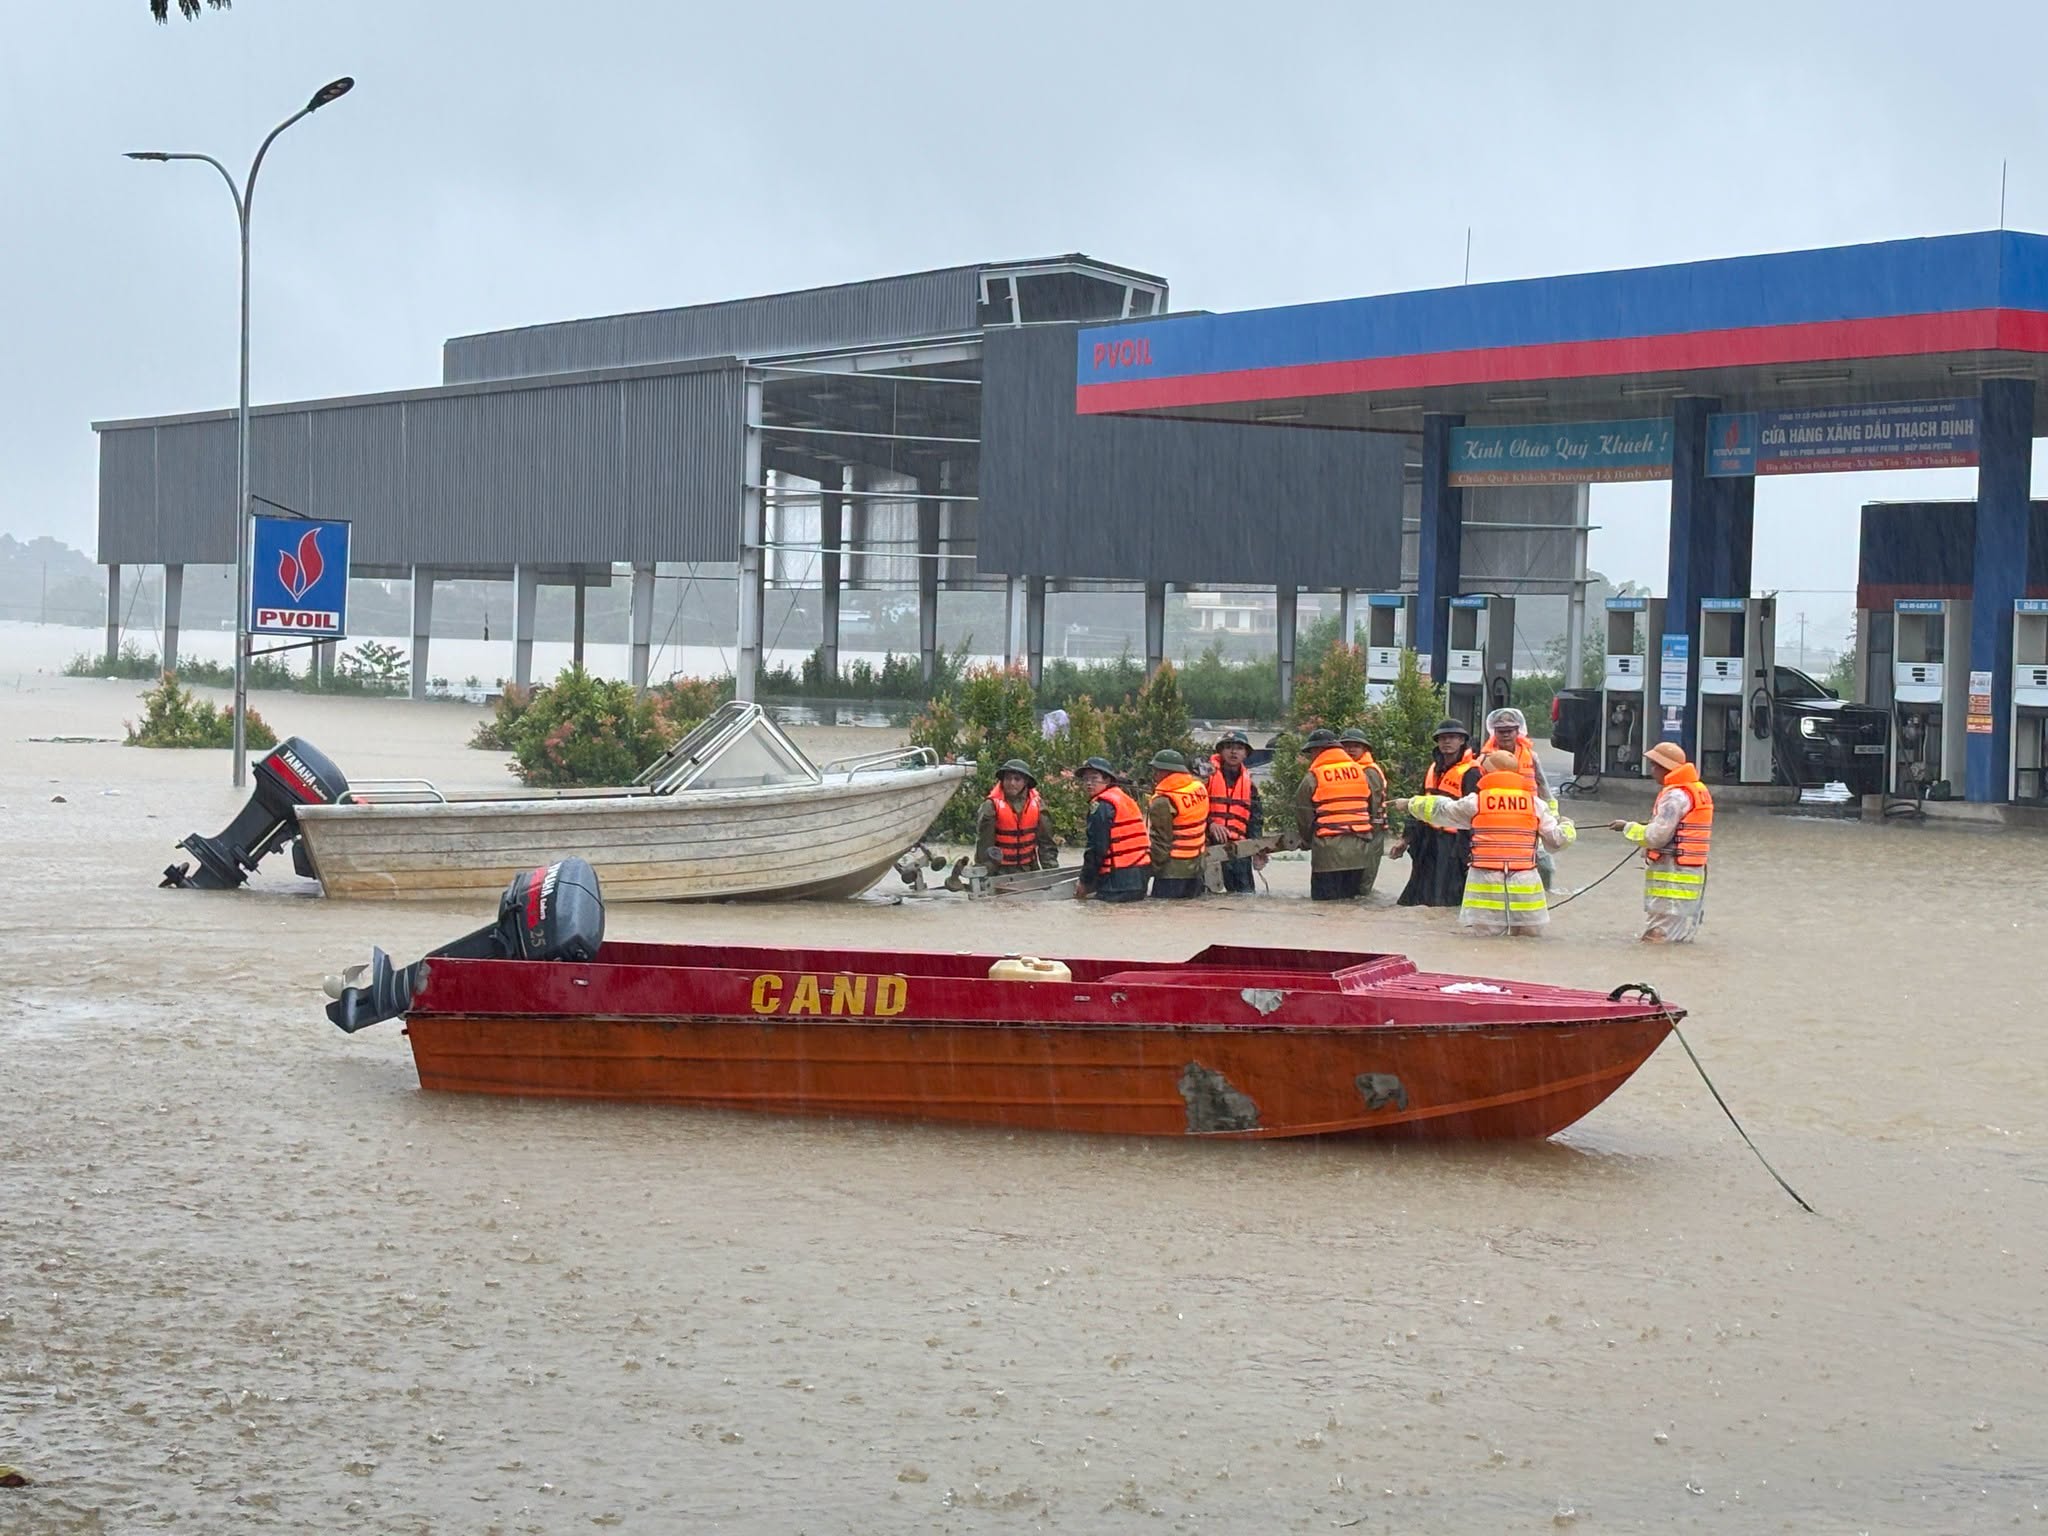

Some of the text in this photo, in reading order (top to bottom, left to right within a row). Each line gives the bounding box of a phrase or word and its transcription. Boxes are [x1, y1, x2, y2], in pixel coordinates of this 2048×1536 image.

[1094, 338, 1153, 370] PVOIL
[1762, 419, 1975, 445] CỬA HÀNG XĂNG DẦU THẠCH ĐỊNH
[260, 610, 337, 629] PVOIL
[282, 750, 317, 787] YAMAHA
[1323, 766, 1360, 782] CAND
[1486, 796, 1528, 811] CAND
[751, 973, 908, 1016] CAND
